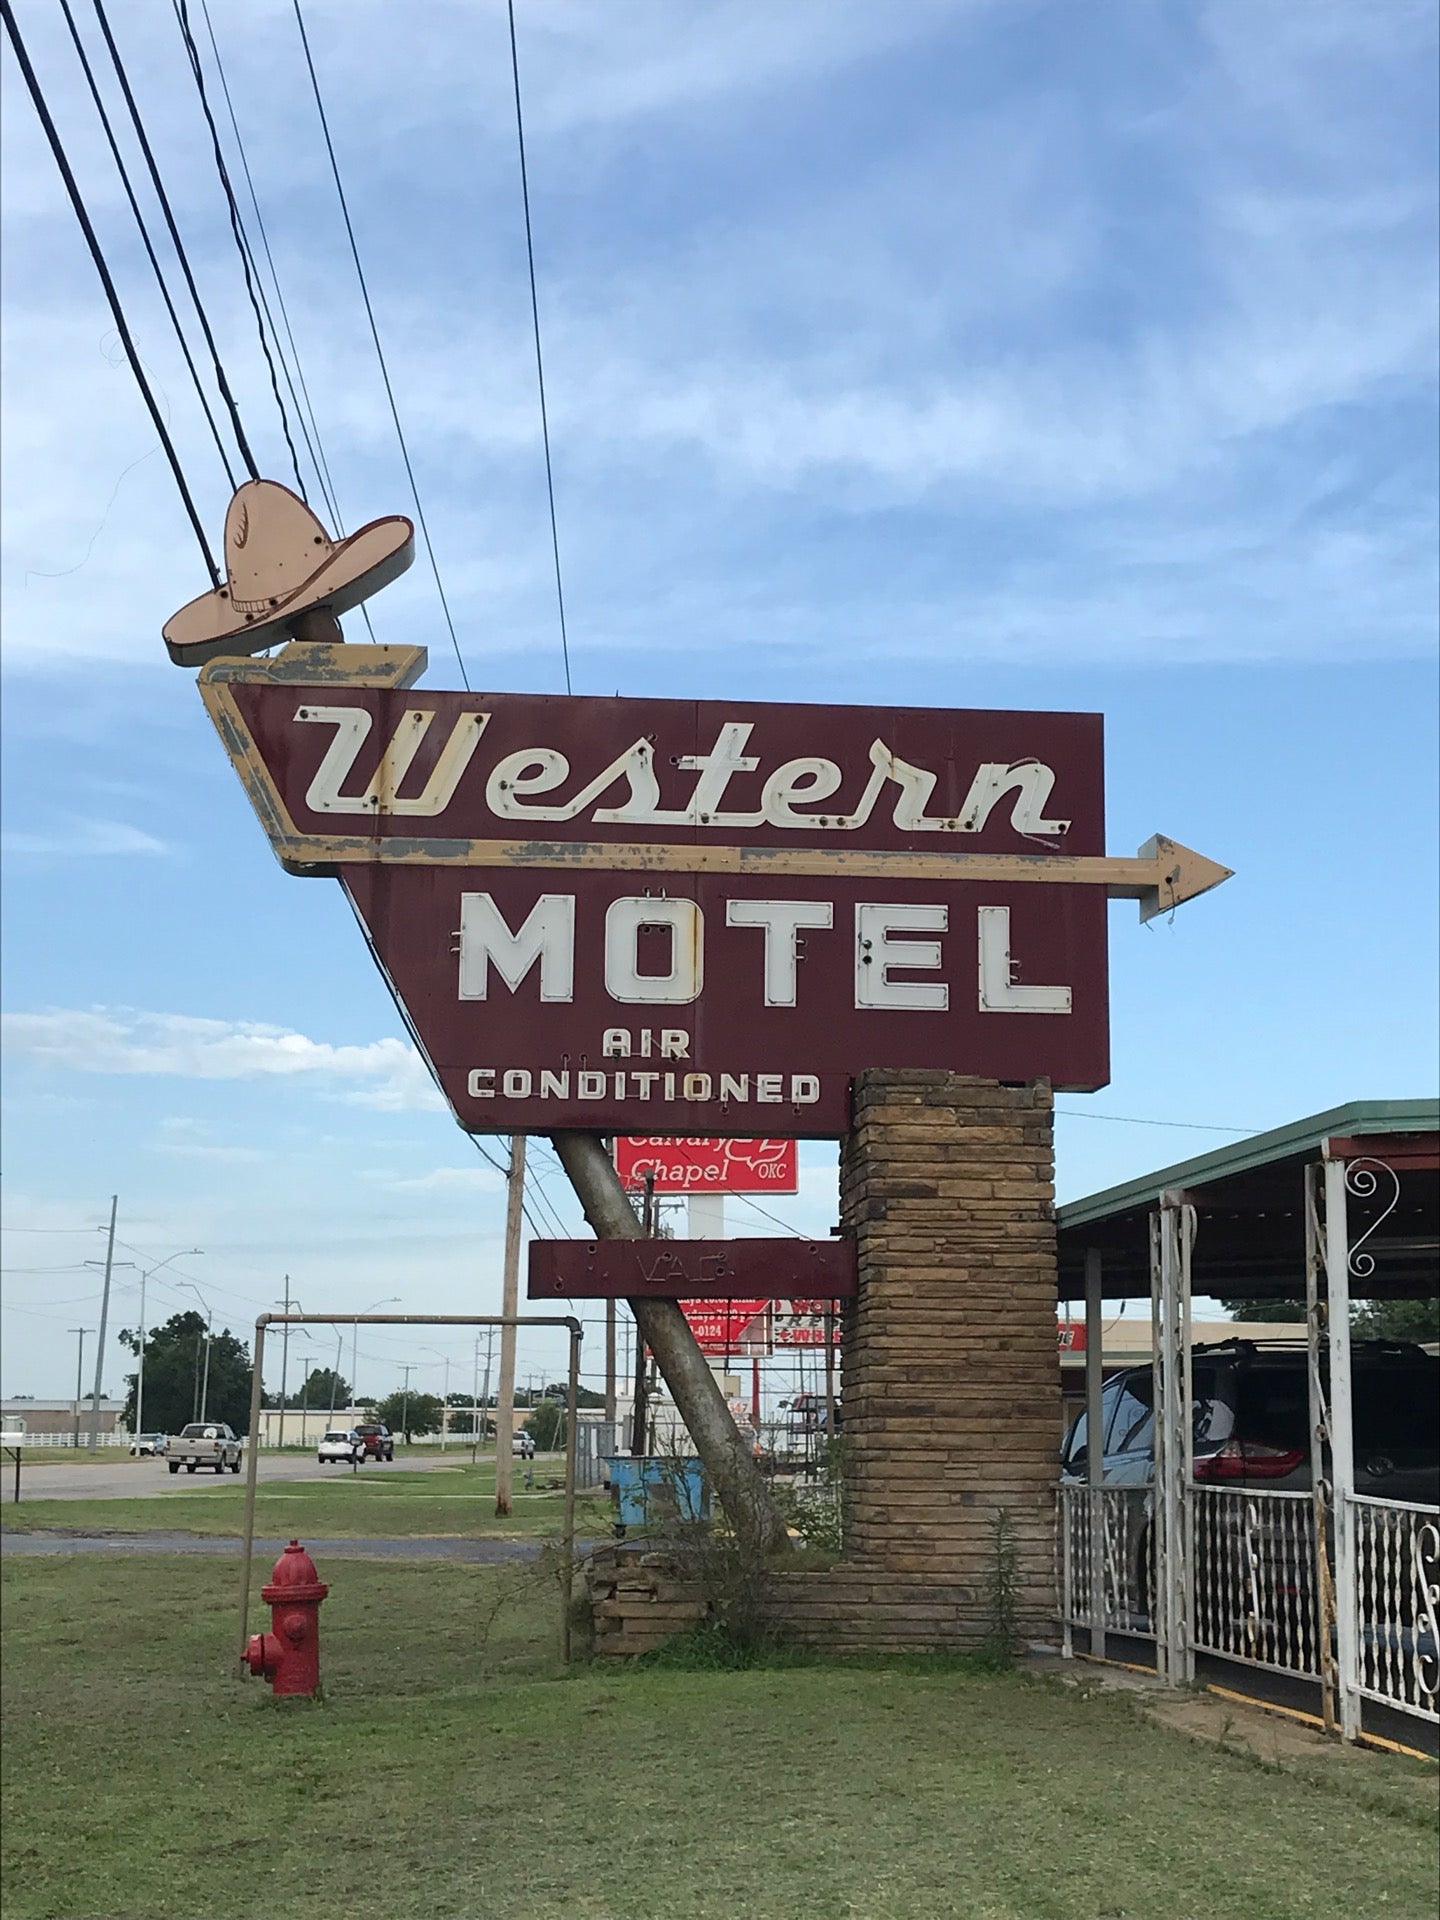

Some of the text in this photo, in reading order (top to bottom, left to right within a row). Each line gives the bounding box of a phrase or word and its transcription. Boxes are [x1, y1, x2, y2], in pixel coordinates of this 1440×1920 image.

[292, 706, 1072, 836] Western
[457, 892, 1072, 1014] MOTEL
[602, 1028, 690, 1058] AIR
[467, 1068, 821, 1104] CONDITIONED
[631, 1158, 729, 1188] Chapel
[758, 1162, 787, 1179] OKC
